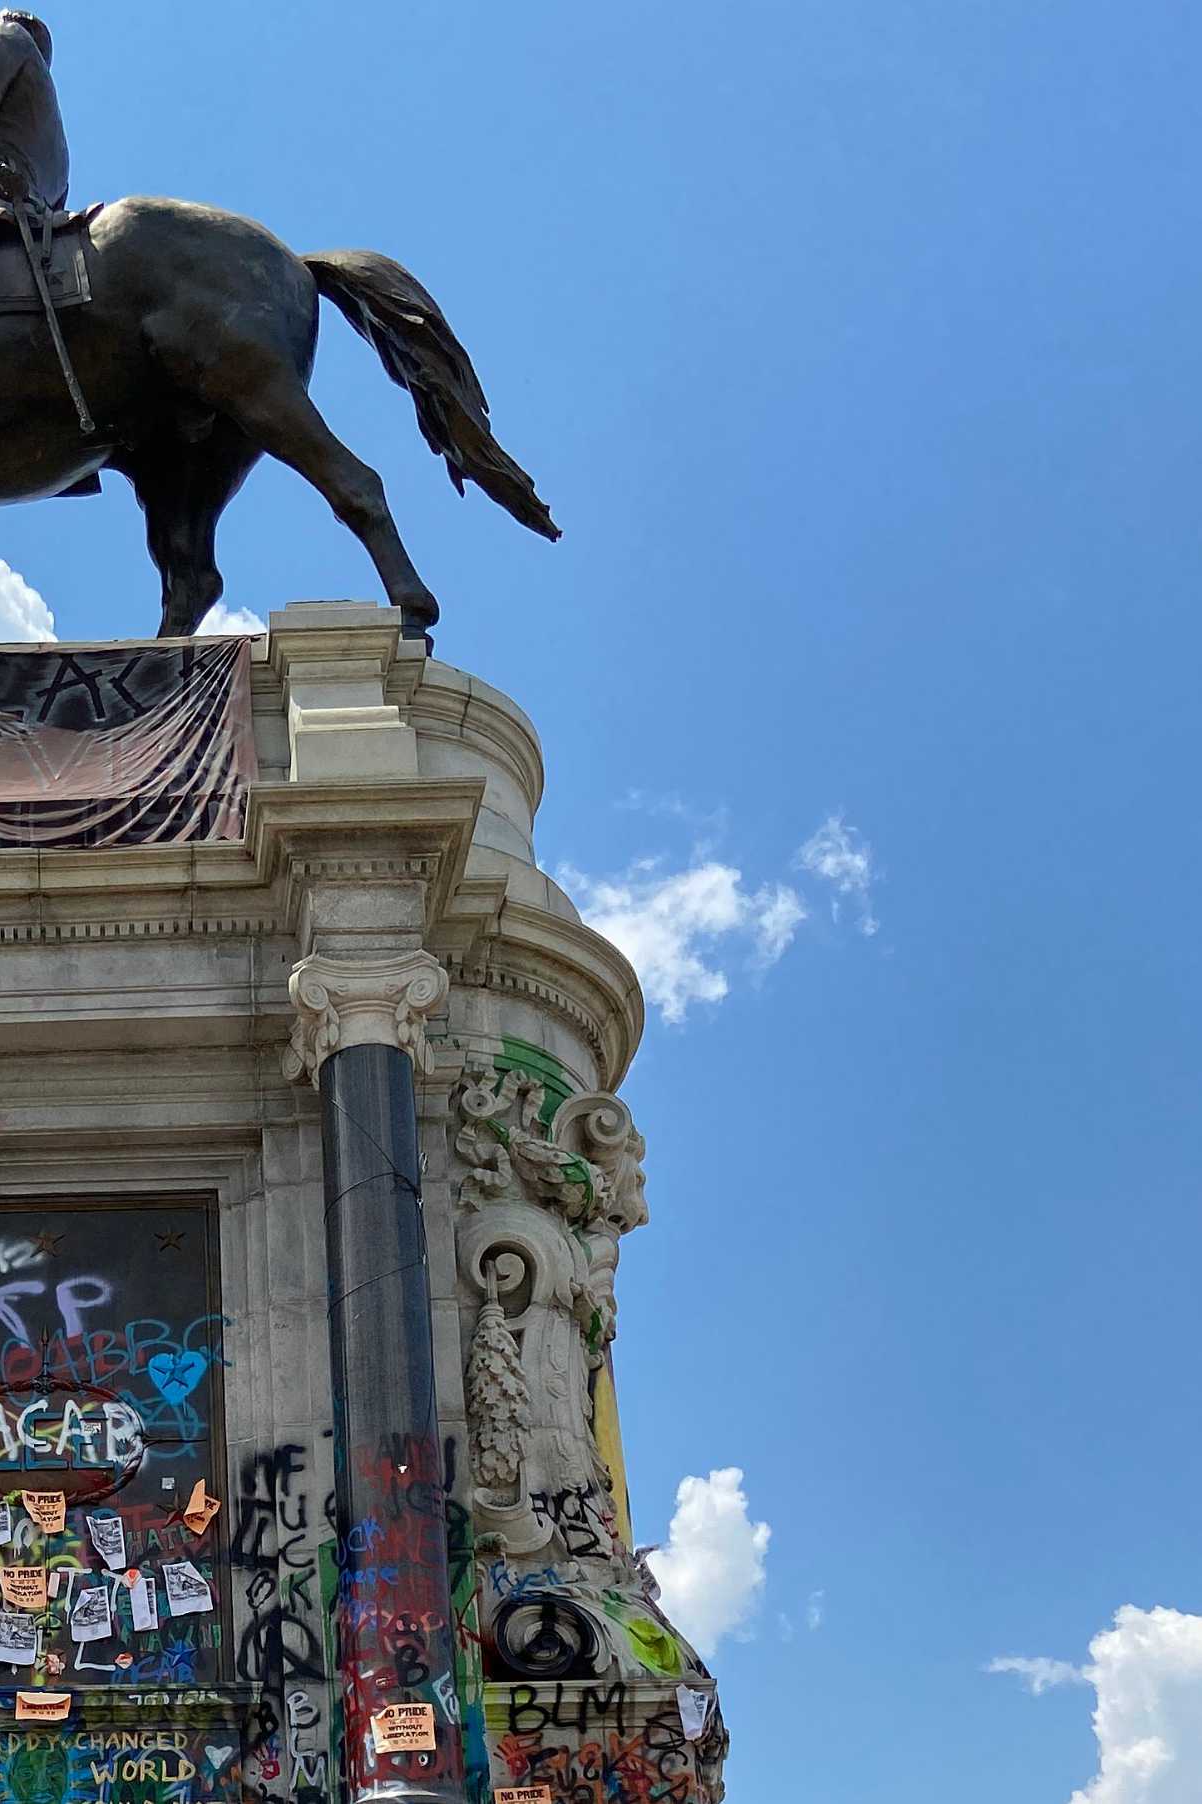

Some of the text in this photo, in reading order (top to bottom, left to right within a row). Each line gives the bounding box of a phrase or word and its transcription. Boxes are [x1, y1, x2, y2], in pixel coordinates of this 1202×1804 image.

[275, 1444, 317, 1613] FUCK
[3, 1569, 43, 1579] NO PRIDE
[398, 1706, 428, 1717] PRIDE
[509, 1681, 626, 1737] BLM
[76, 1731, 189, 1751] CHANGED
[286, 1690, 328, 1799] BLM
[382, 1731, 429, 1740] LIBERATION
[90, 1758, 197, 1785] WORLD
[501, 1789, 545, 1801] NO PRIDE
